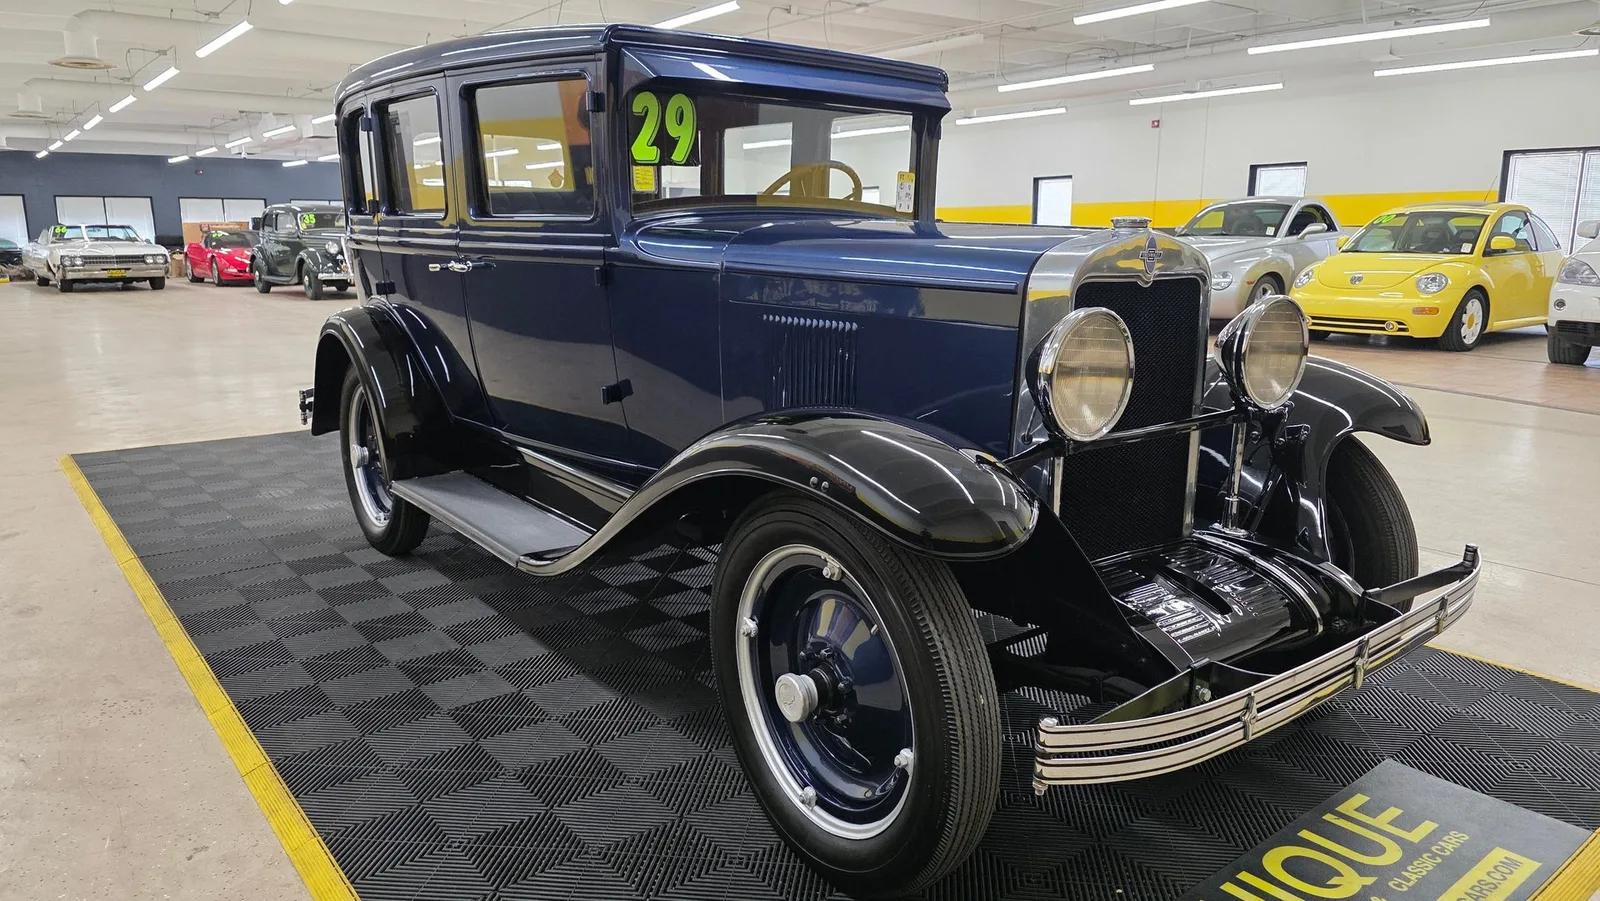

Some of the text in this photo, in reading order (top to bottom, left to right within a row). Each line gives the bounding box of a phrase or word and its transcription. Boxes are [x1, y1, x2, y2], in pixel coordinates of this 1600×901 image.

[631, 91, 697, 165] 29
[1388, 831, 1470, 892] CLASSIC CARS
[1456, 856, 1523, 901] ARS.COM
